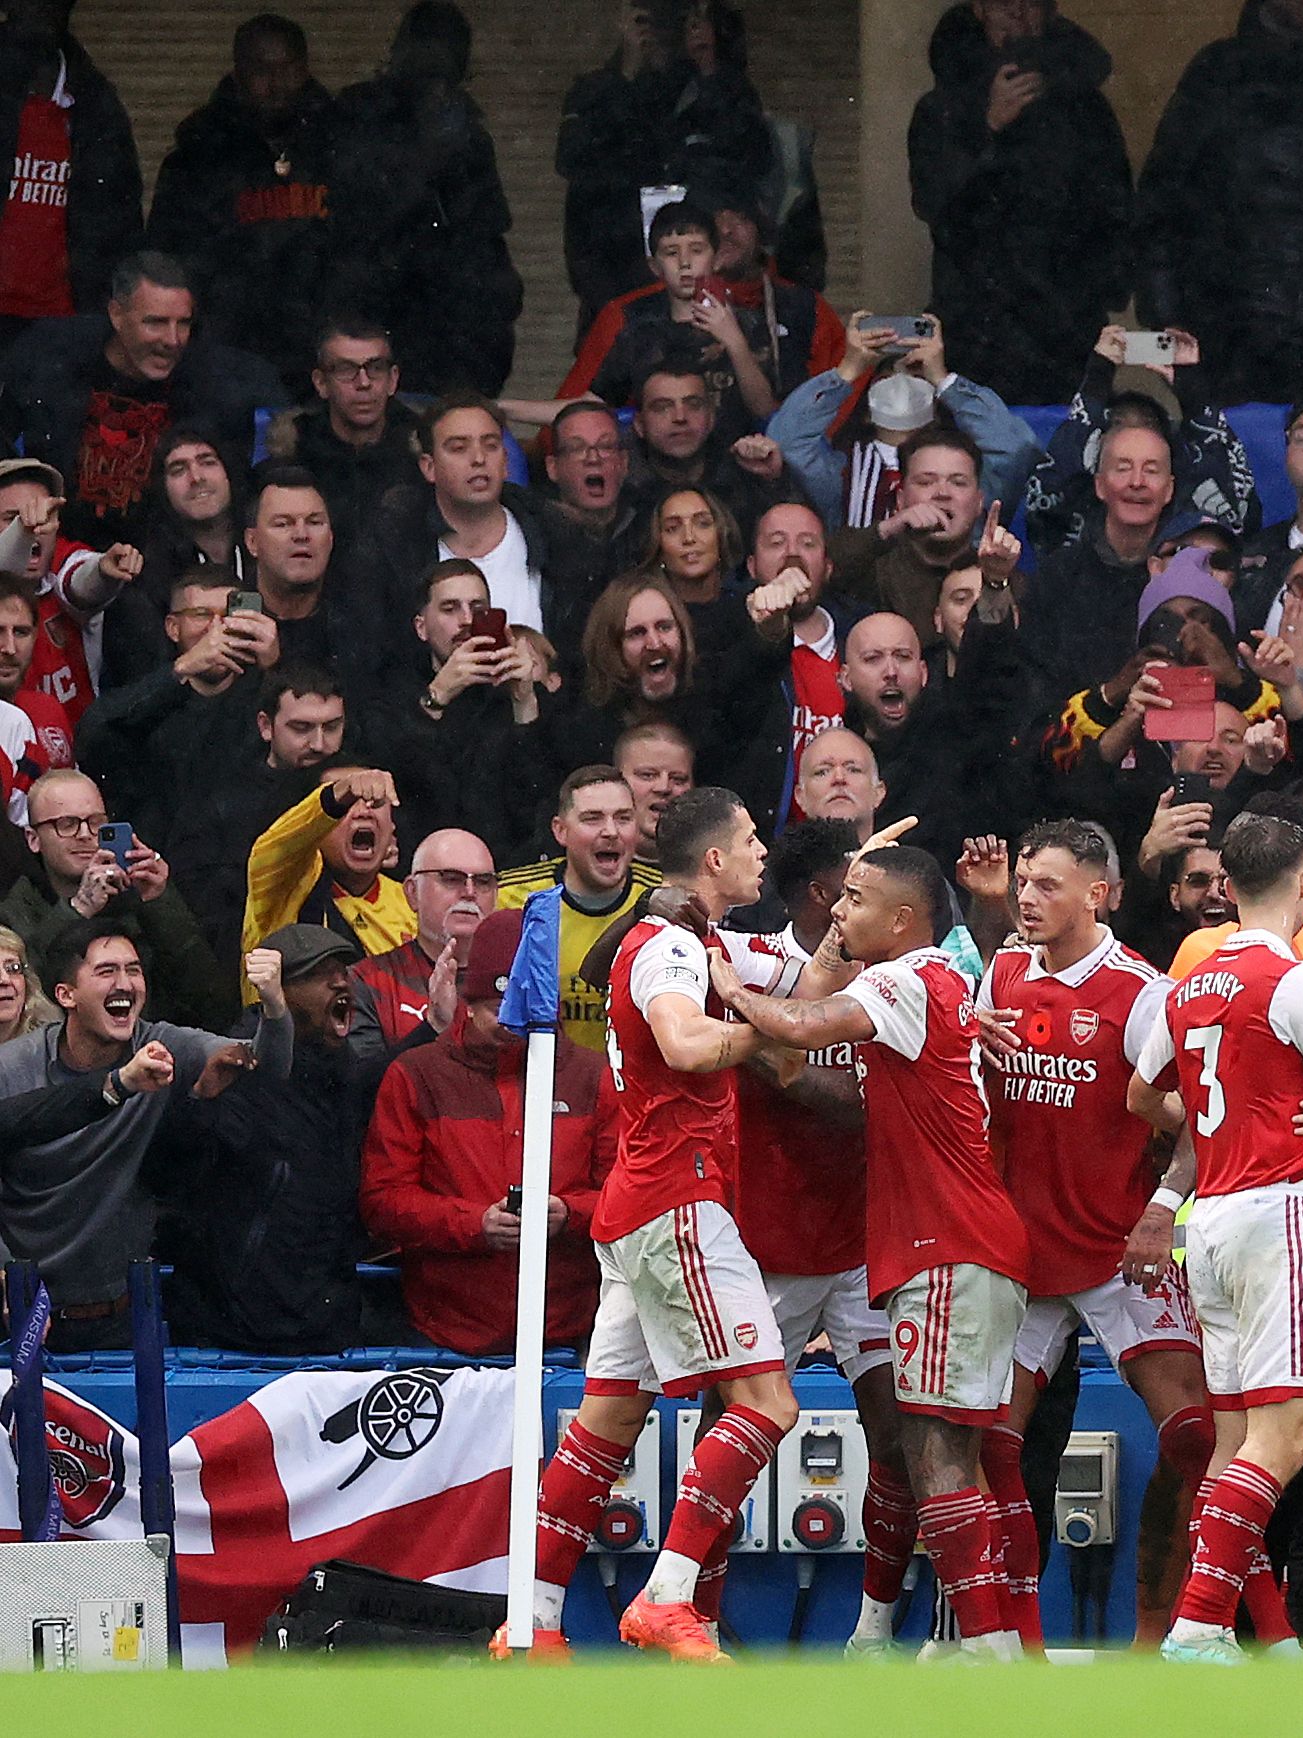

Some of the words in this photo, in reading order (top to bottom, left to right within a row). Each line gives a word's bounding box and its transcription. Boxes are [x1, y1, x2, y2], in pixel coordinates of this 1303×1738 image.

[1175, 971, 1246, 1009] TIERNEY
[1005, 1078, 1027, 1101] FLY
[1027, 1079, 1076, 1108] BETTER
[1184, 1024, 1226, 1138] 3
[16, 1300, 49, 1366] MUSEUM
[895, 1319, 921, 1369] 9
